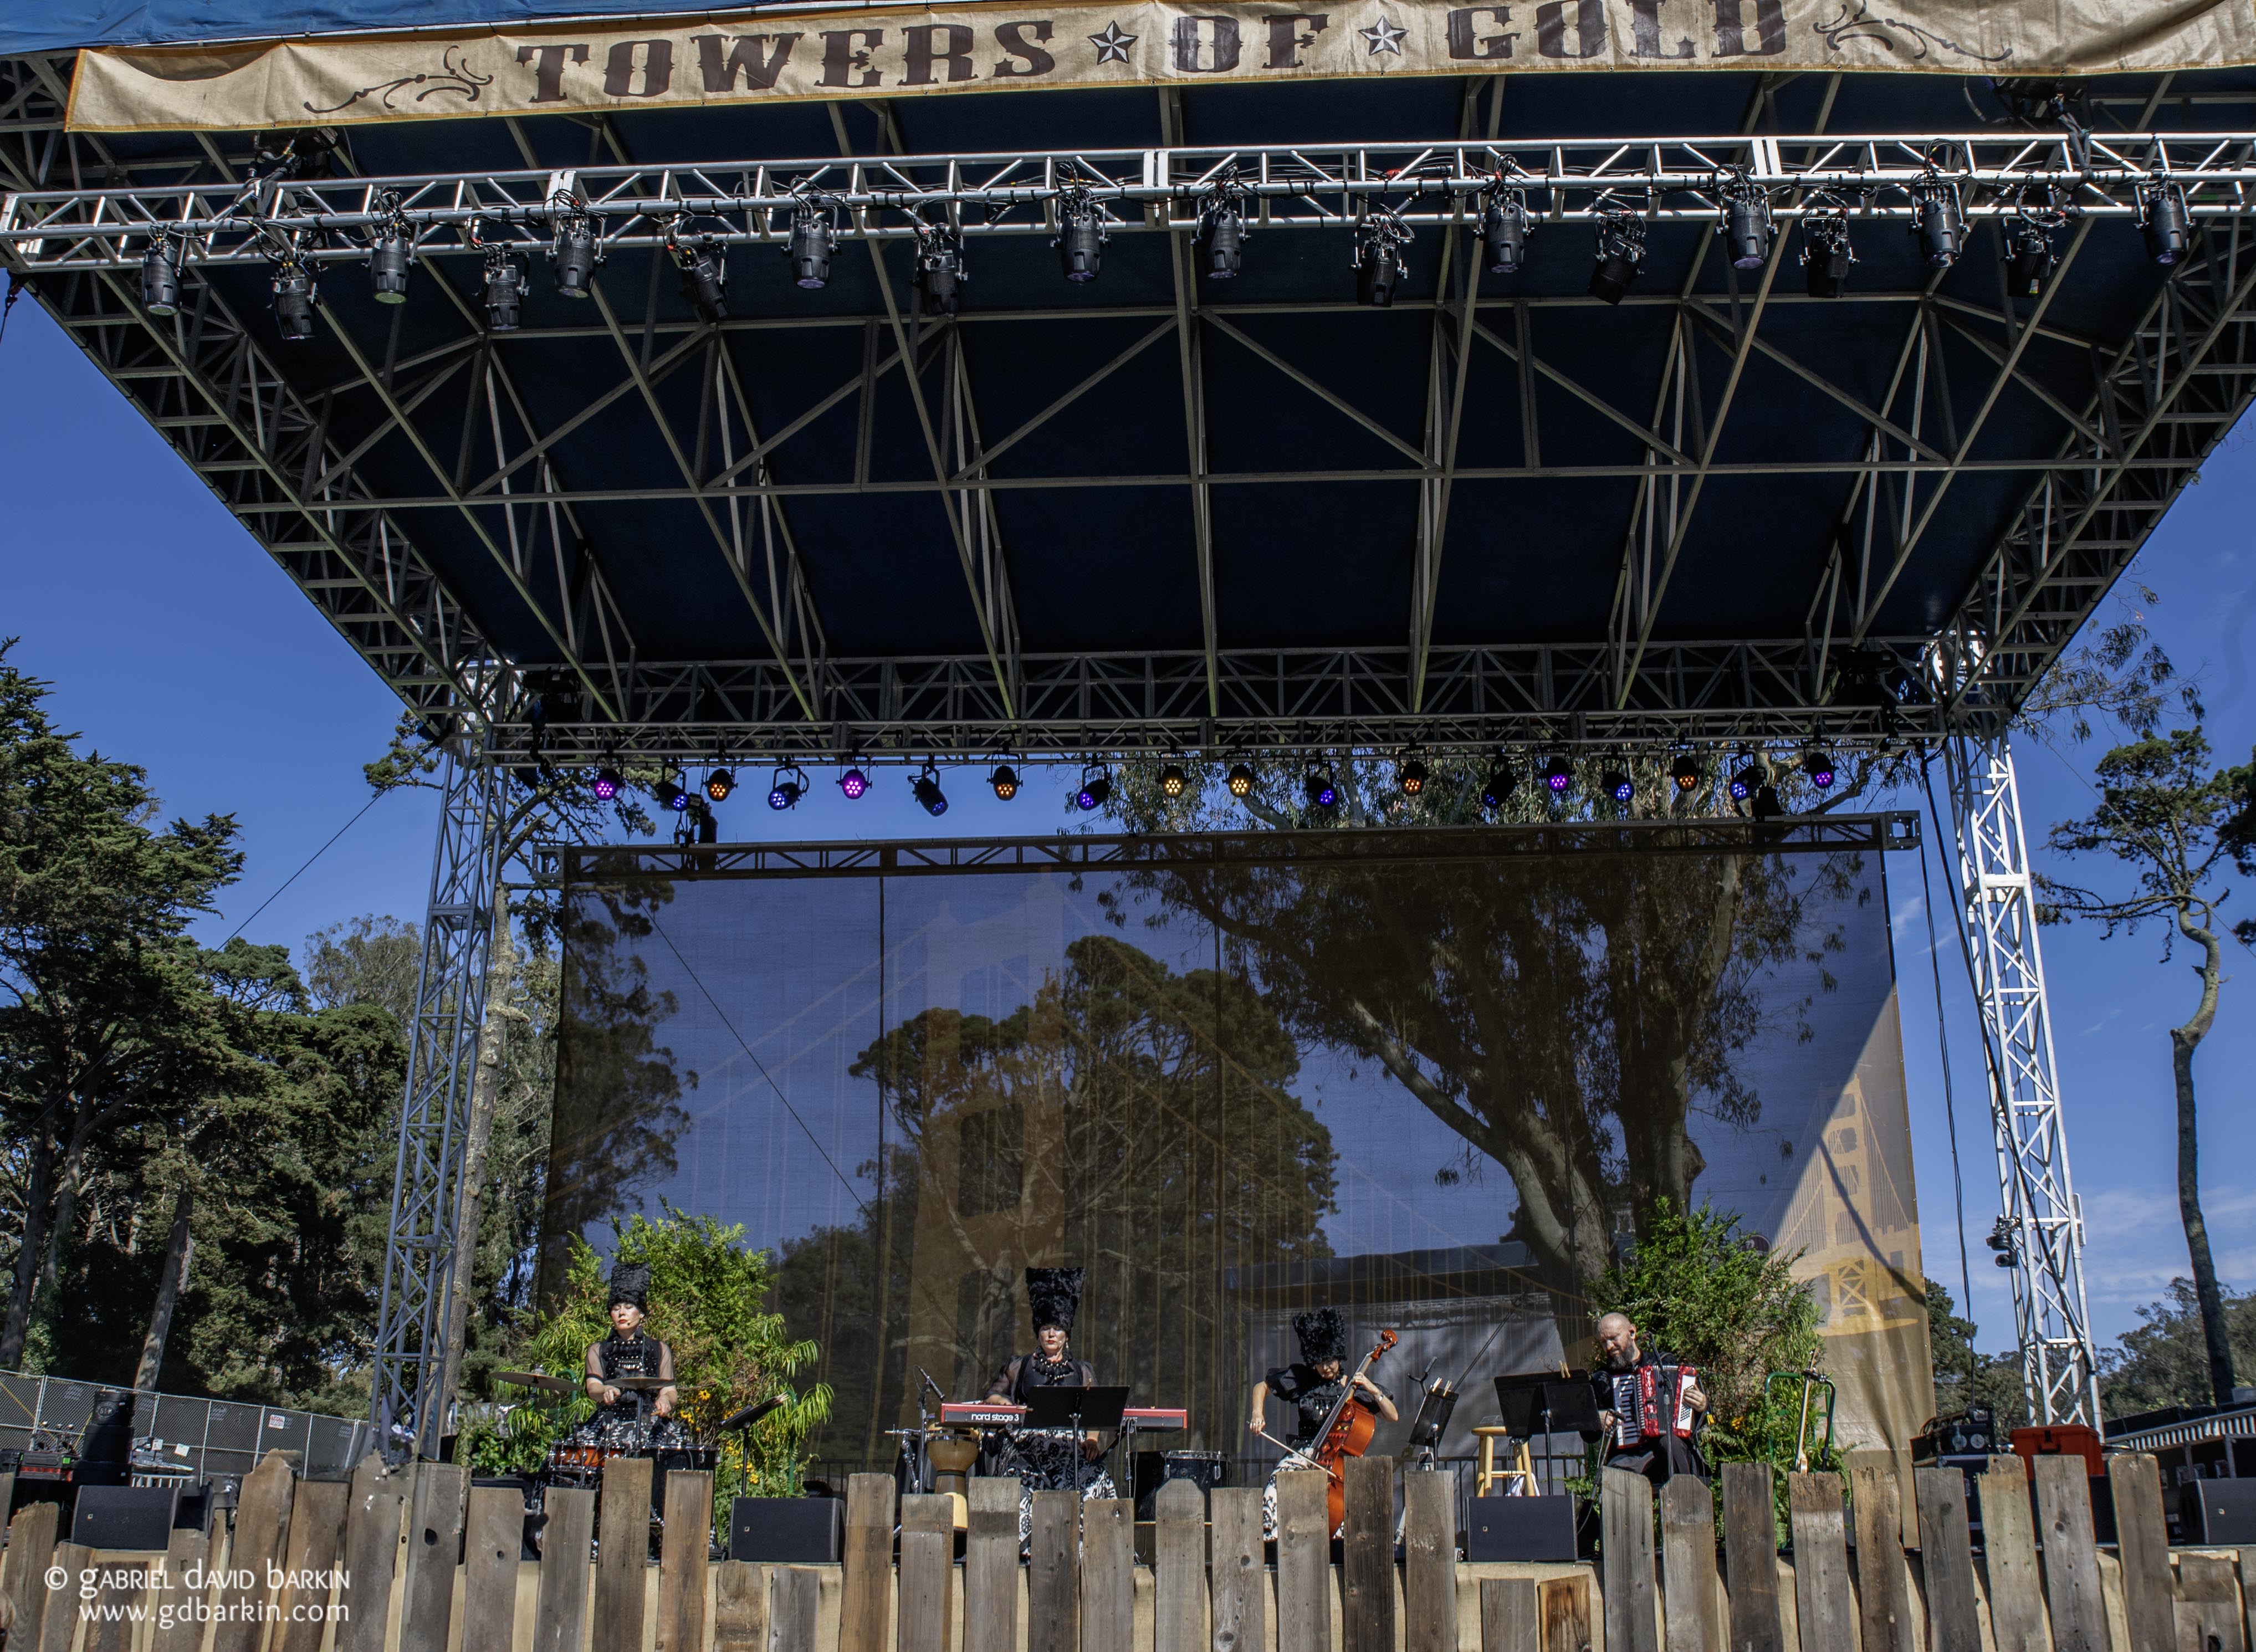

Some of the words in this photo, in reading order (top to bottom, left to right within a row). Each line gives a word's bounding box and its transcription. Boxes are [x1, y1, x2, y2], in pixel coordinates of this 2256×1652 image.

[516, 20, 1056, 103] TOWERS
[1168, 13, 1329, 73] OF
[1444, 0, 1788, 59] GOLD
[991, 1413, 1012, 1422] stage
